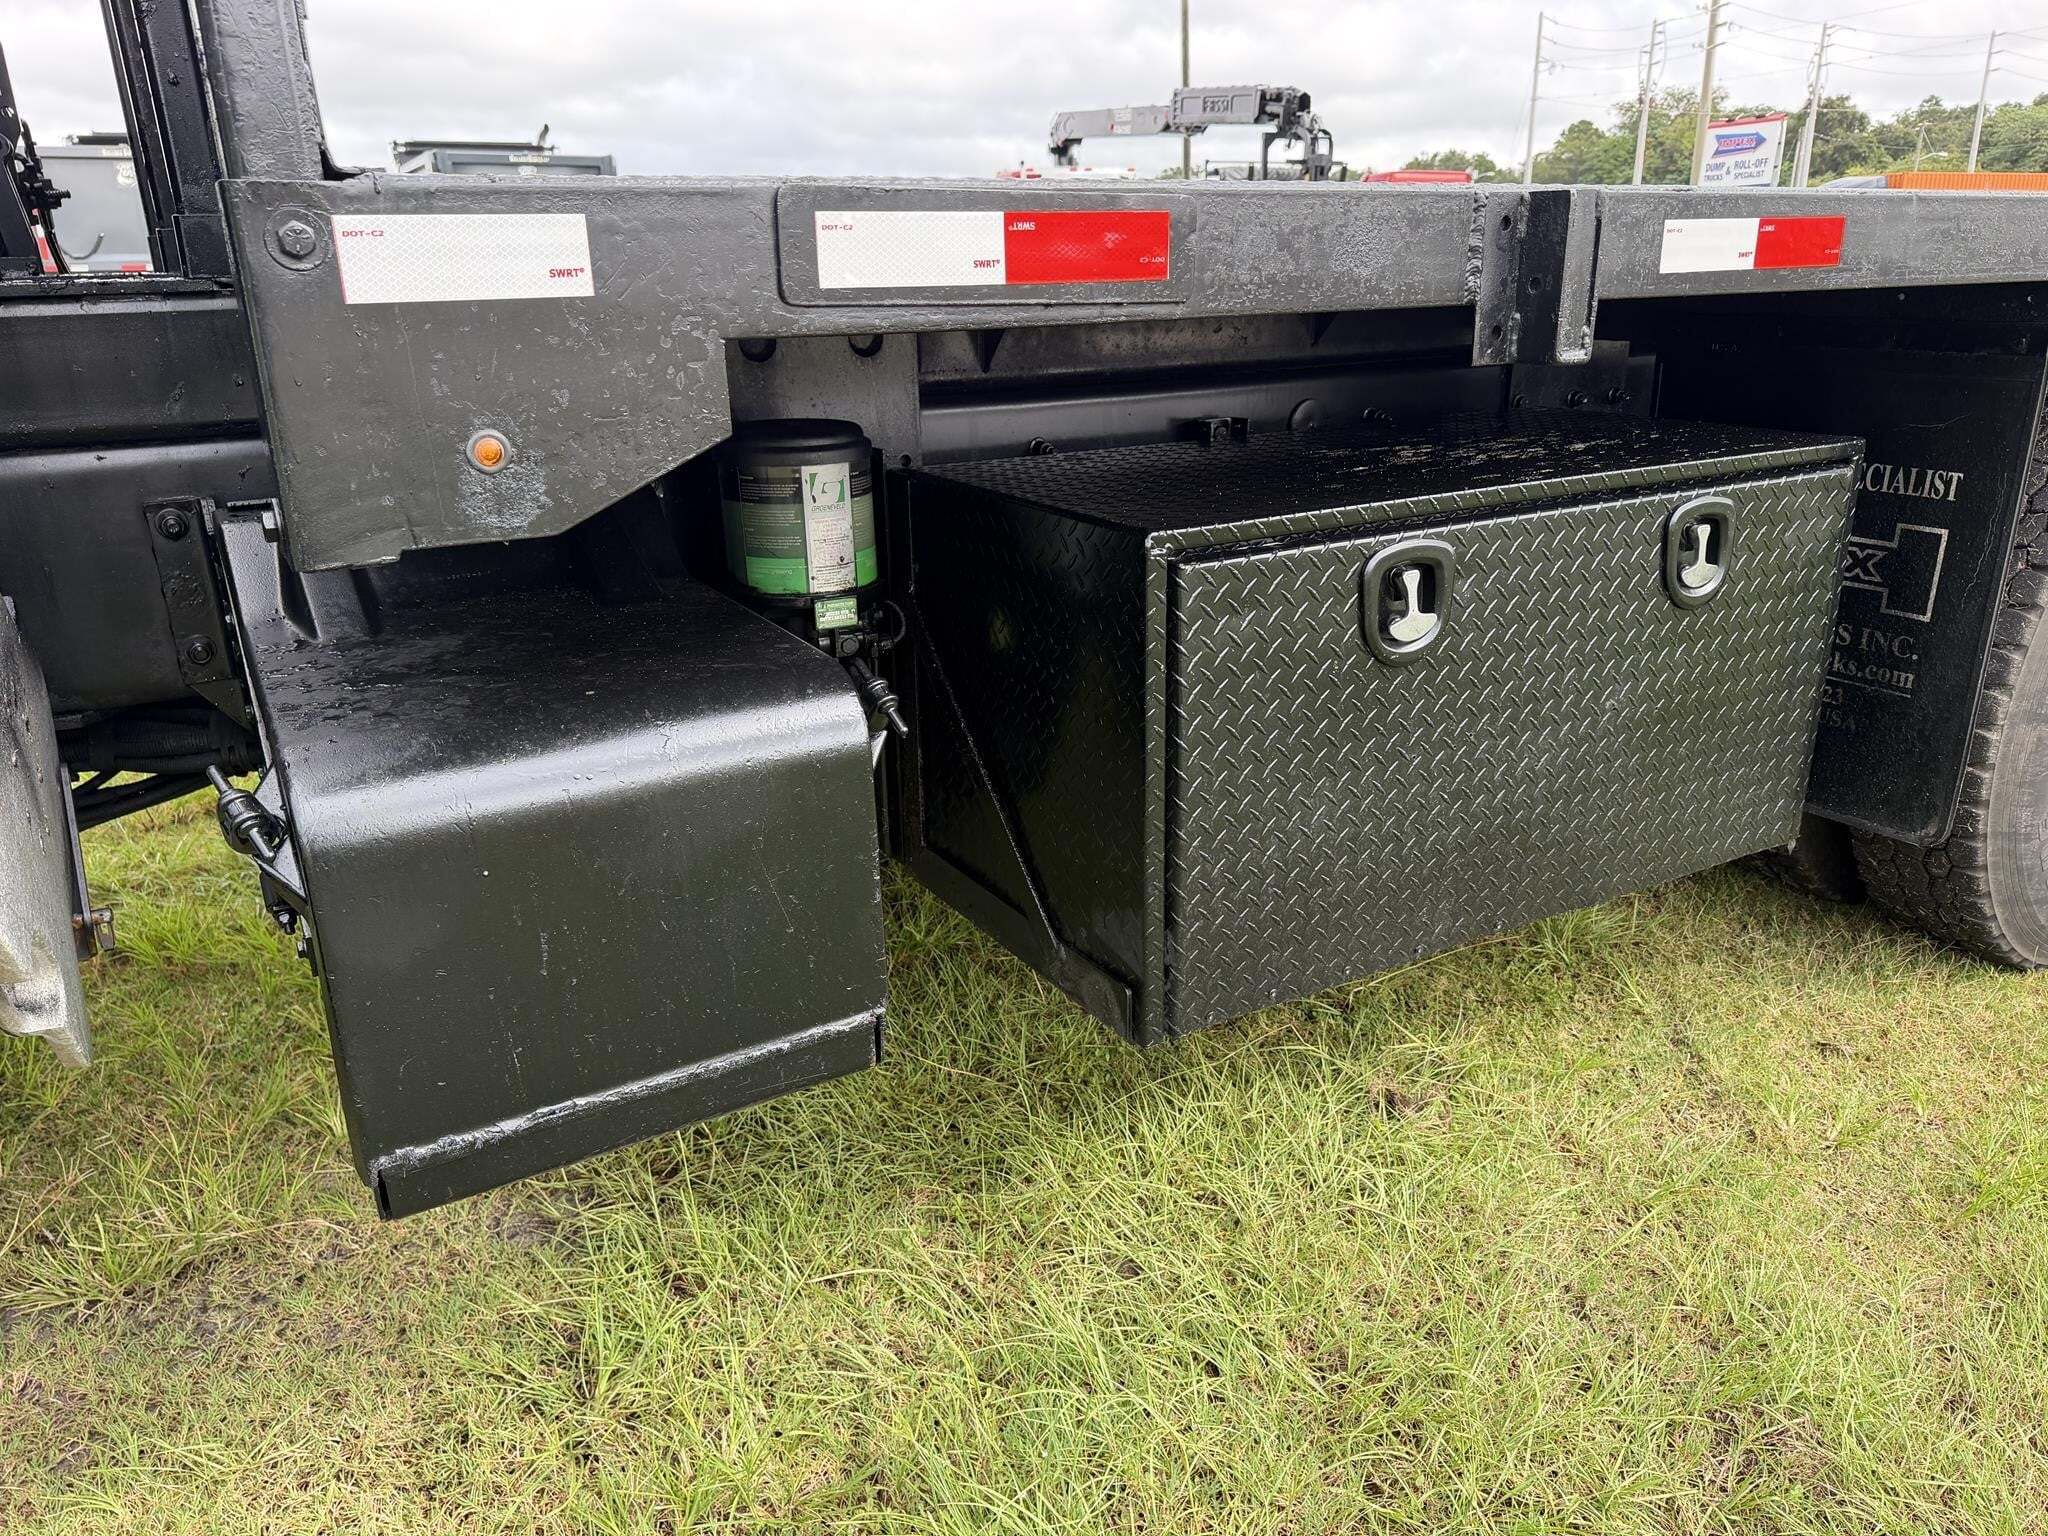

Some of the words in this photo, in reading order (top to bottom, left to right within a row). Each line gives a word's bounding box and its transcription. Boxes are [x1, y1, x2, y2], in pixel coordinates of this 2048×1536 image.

[1706, 161, 1726, 173] DUMP
[1734, 158, 1769, 170] ROLL-OFF
[1734, 170, 1765, 180] SPECIALIST
[821, 223, 853, 232] DOT-C2
[341, 229, 385, 238] DOT-C2
[1858, 627, 1919, 661] INC.
